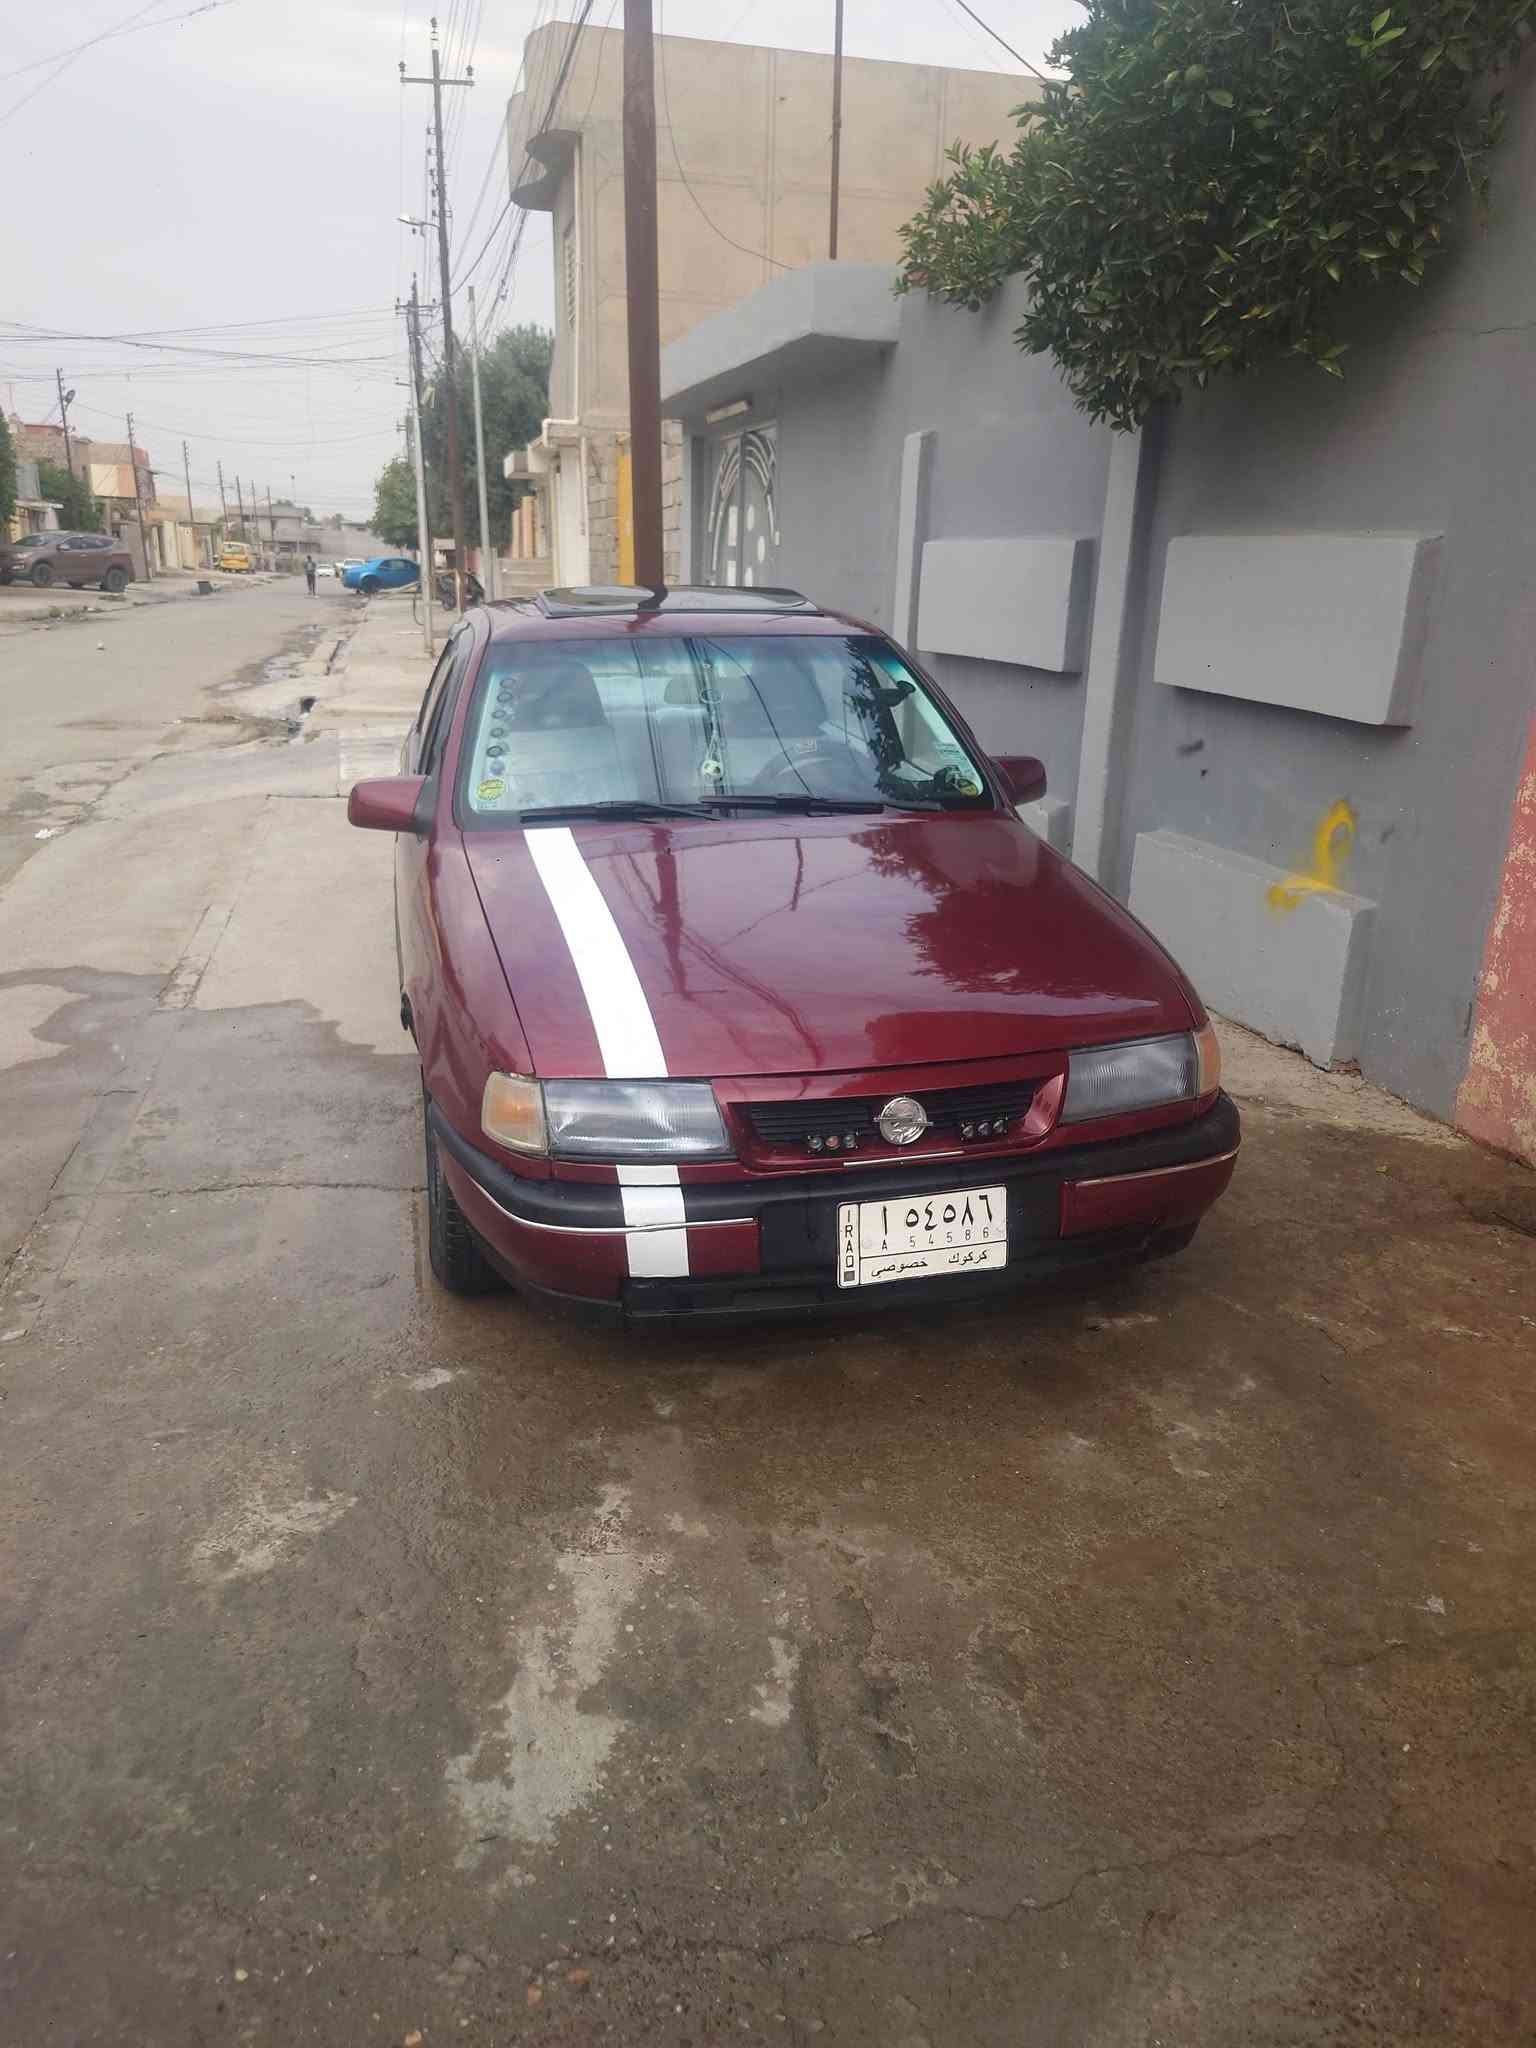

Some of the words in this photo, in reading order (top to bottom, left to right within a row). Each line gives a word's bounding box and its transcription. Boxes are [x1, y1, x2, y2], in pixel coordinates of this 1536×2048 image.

[906, 1194, 993, 1231] ٥٤٥٨٦
[844, 1210, 854, 1268] IRAQ
[881, 1239, 888, 1251] A
[871, 1257, 928, 1278] خصوصي
[948, 1250, 988, 1266] كركوك
